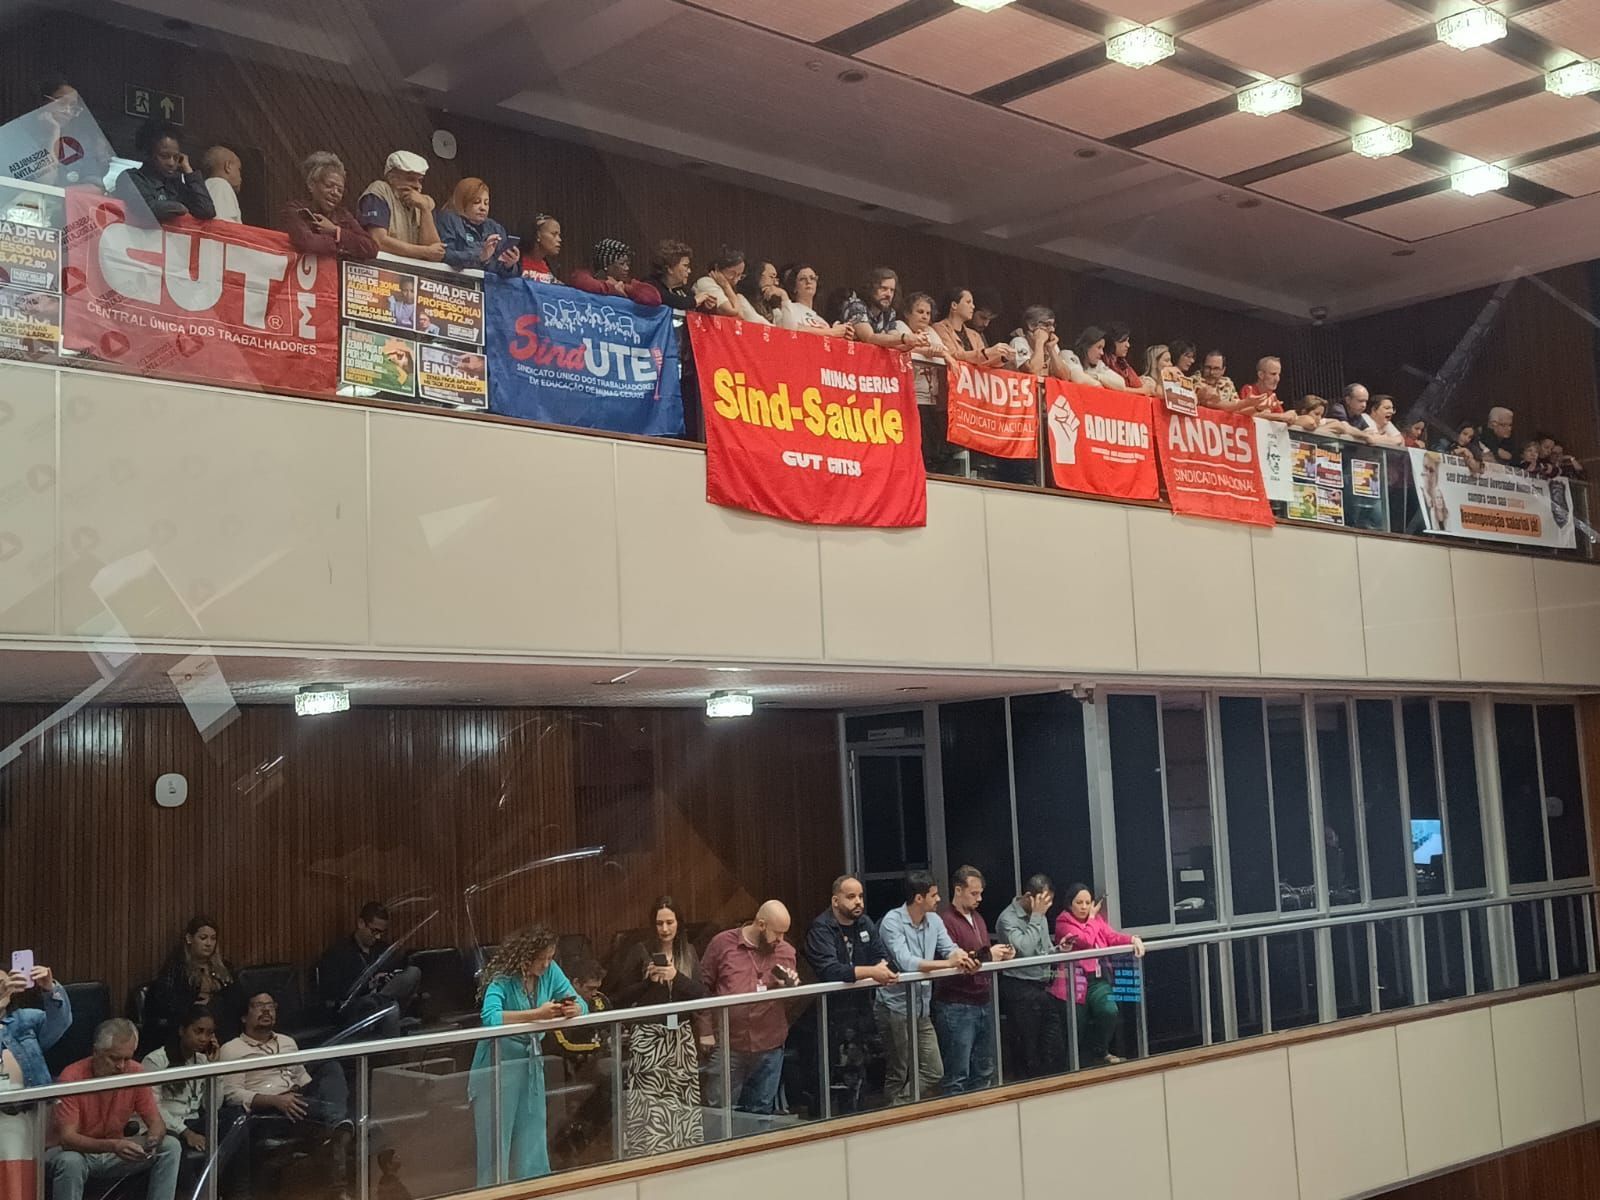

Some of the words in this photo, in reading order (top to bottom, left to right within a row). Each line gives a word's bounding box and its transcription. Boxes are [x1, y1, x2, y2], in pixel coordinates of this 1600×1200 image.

[15, 224, 56, 243] DEVE
[420, 280, 450, 296] ZEMA
[452, 287, 480, 303] DEVE
[418, 295, 481, 318] PROFESSOR(A)
[87, 301, 146, 327] CENTRAL
[150, 316, 185, 334] ÚNICA
[189, 324, 215, 337] DOS
[218, 328, 317, 355] TRABALHADORES
[517, 363, 555, 378] SINDICATO
[581, 375, 597, 385] DOS
[597, 377, 655, 391] TRABALHADORES
[820, 367, 857, 391] MINAS
[858, 375, 900, 394] GERAIS
[956, 364, 1034, 408] ANDES
[713, 367, 904, 445] Sind-Saúde
[956, 408, 996, 431] SINDICATO
[1084, 413, 1149, 449] ADUEMG
[1168, 414, 1253, 464] ANDES
[1173, 468, 1219, 486] SINDICATO
[1219, 473, 1257, 493] NACIONAL
